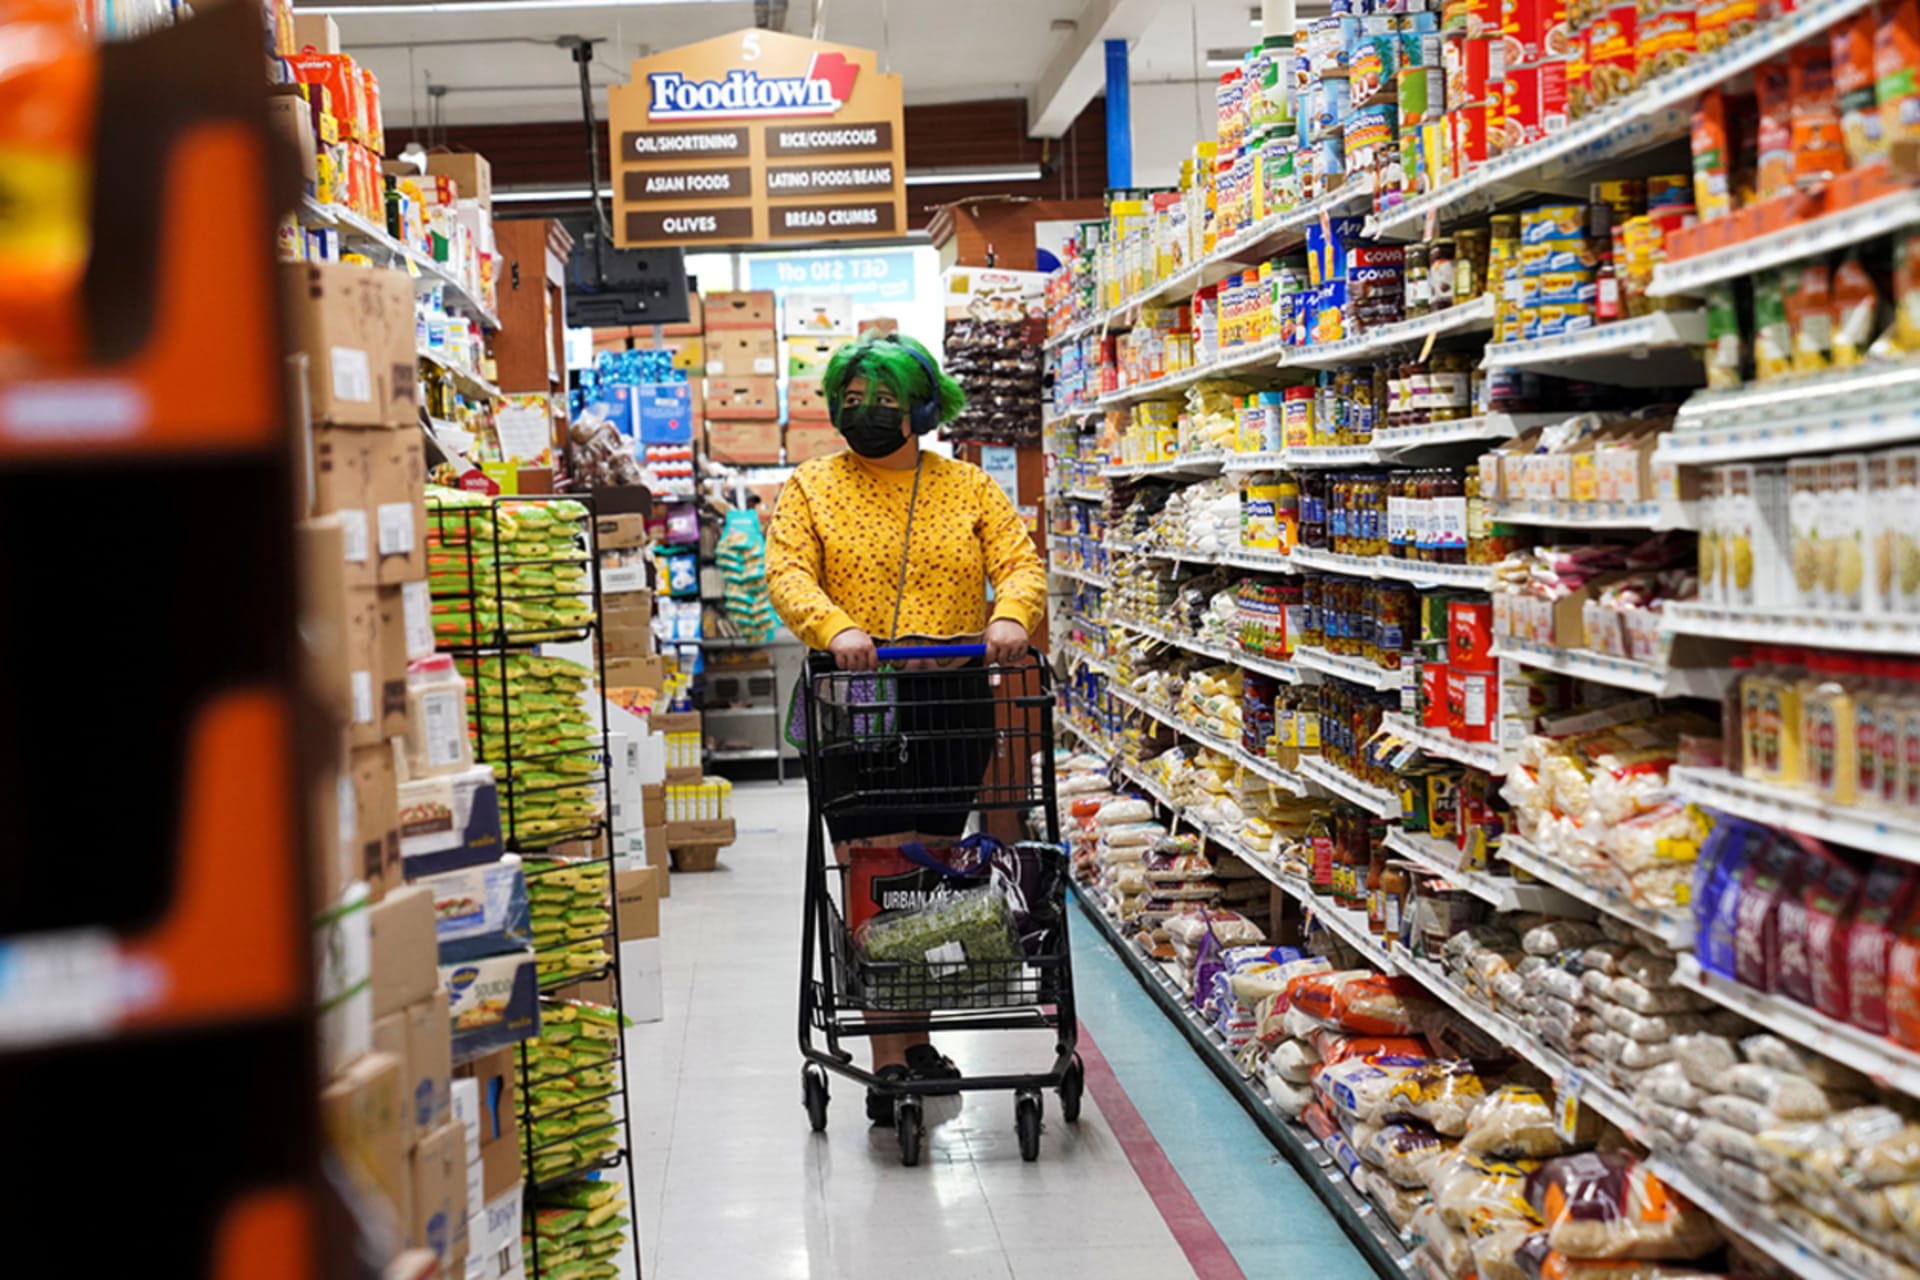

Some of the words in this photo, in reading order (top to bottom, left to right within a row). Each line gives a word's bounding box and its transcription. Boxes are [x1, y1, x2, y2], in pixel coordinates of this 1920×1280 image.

[742, 33, 761, 61] 5
[649, 70, 834, 111] Foodtown
[635, 133, 738, 152] OIL/SHORTENING
[779, 129, 878, 148] RICE/COUSCOUS
[645, 175, 685, 192] ASIAN
[687, 173, 731, 190] FOODS
[768, 171, 809, 188] LATINO
[811, 168, 892, 186] FOODS/BEANS
[662, 216, 717, 233] OLIVES
[785, 210, 826, 227] BREAD
[828, 208, 878, 225] CRUMBS
[883, 890, 927, 909] URBAN
